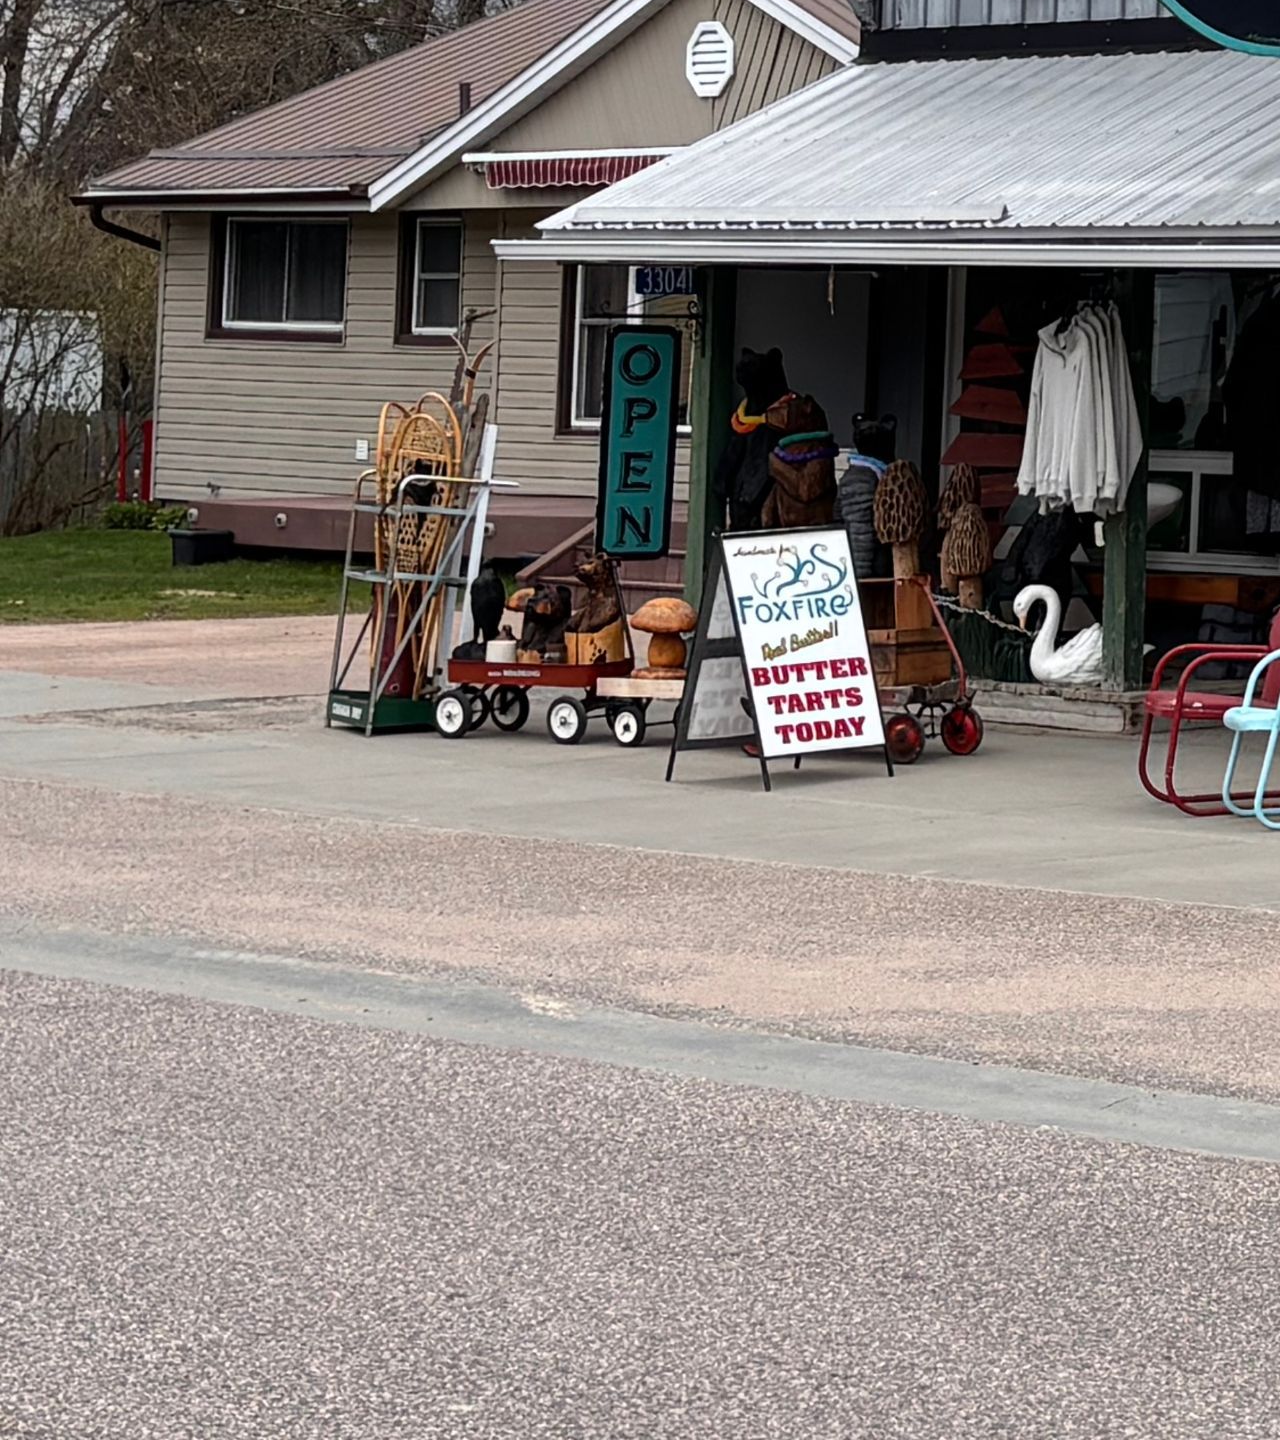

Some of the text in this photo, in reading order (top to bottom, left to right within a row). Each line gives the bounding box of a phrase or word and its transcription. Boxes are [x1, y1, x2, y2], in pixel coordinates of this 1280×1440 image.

[643, 267, 693, 293] 33041
[614, 343, 662, 548] OPEN
[751, 657, 868, 686] BUTTER
[767, 687, 863, 715] TARTS
[775, 716, 866, 744] TODAY
